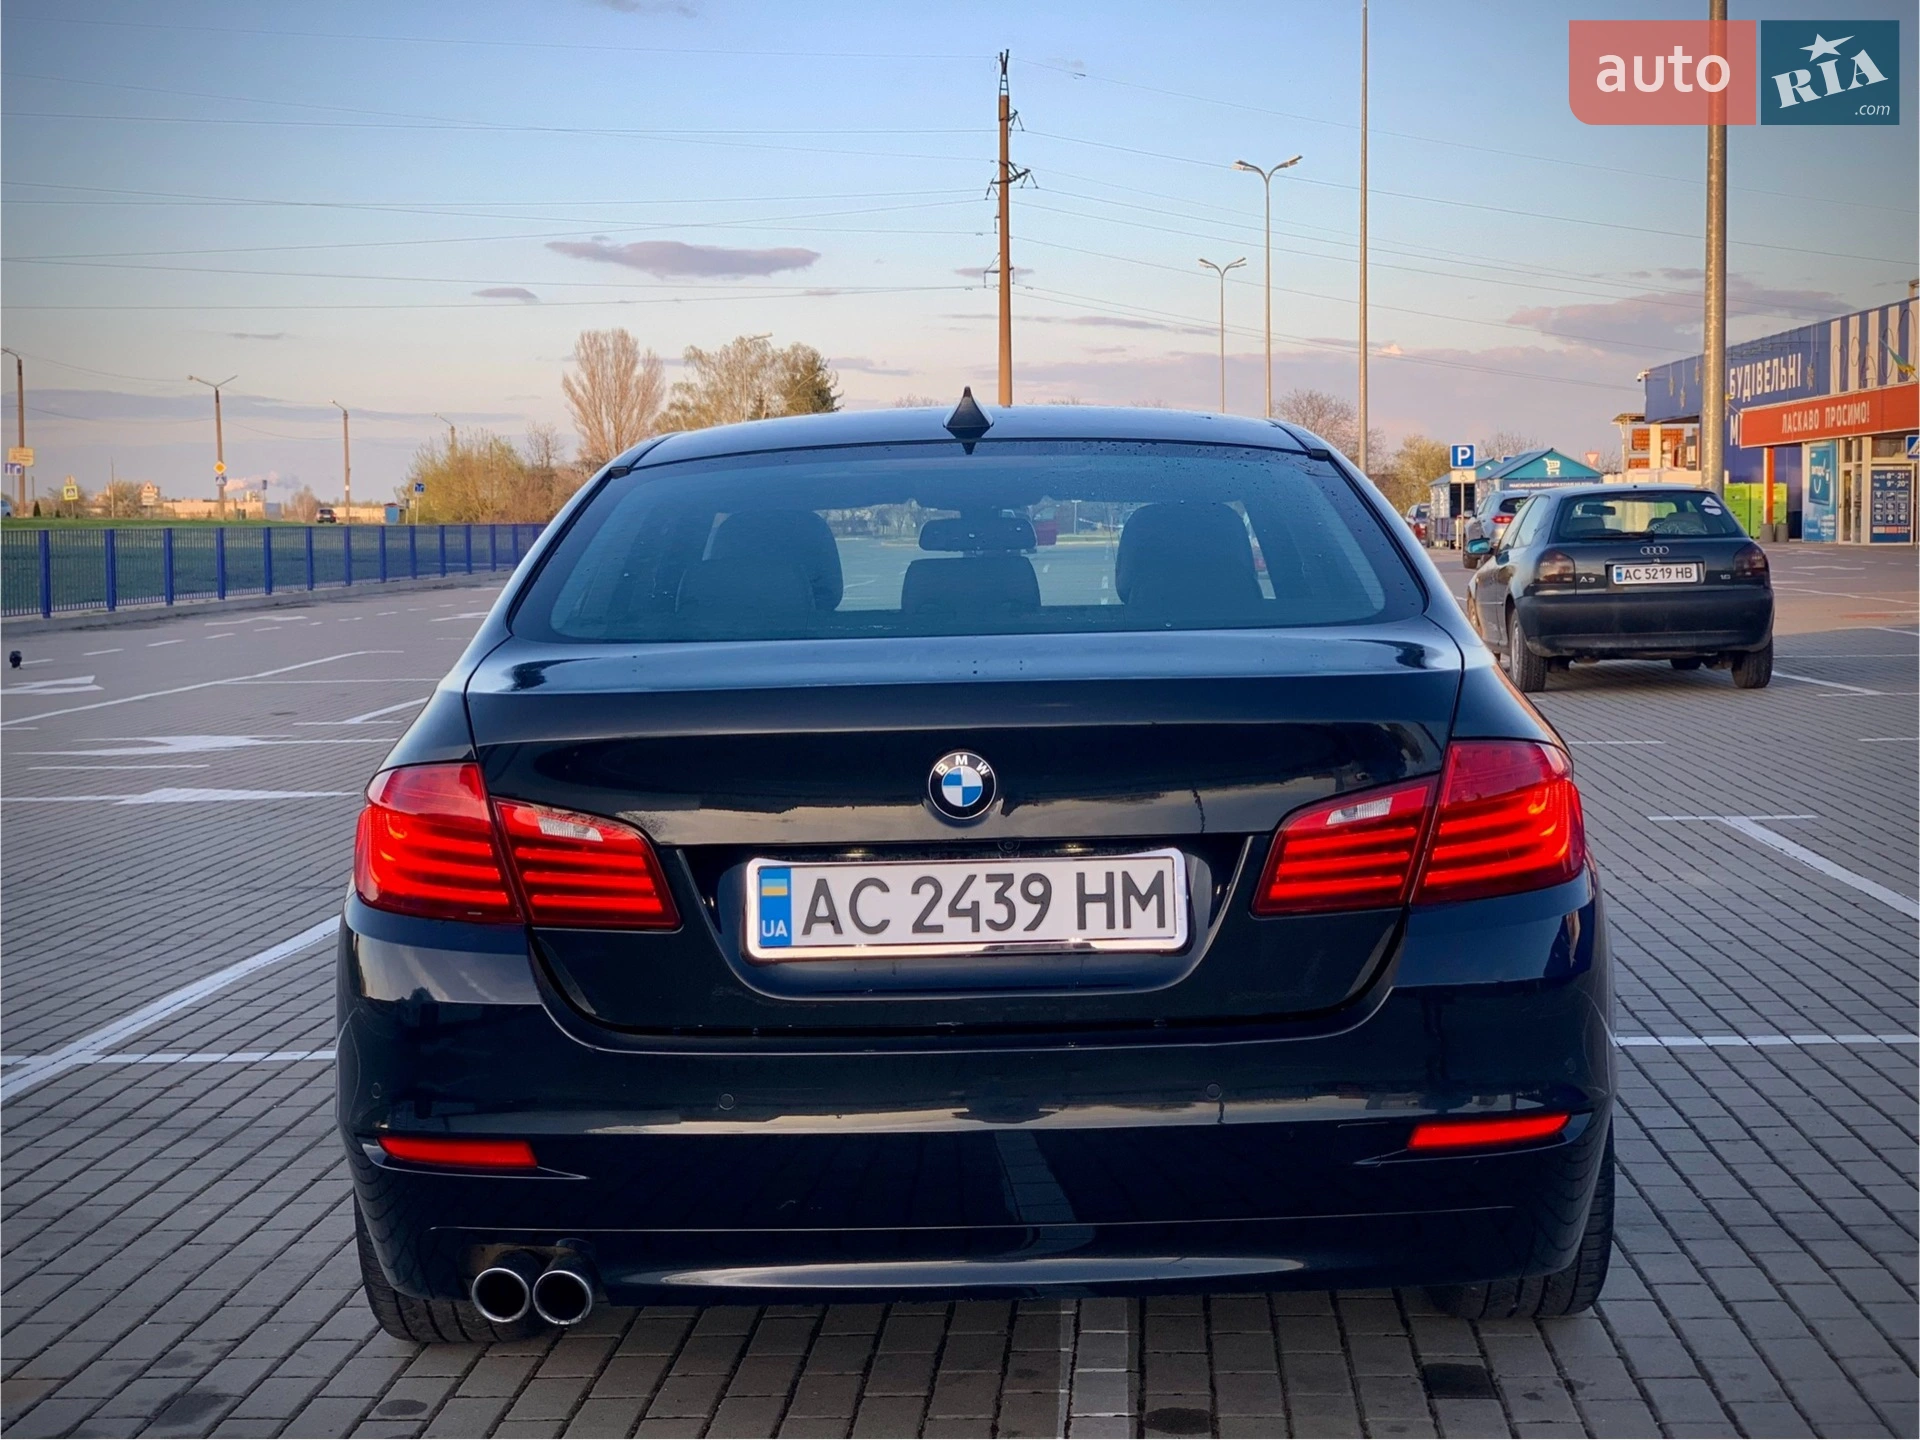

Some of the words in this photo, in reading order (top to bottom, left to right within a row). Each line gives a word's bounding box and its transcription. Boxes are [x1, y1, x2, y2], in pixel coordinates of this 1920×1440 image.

[1729, 353, 1801, 403] БУДІВЕЛЬНІ
[1782, 408, 1820, 434] ЛАСКАВО
[1825, 400, 1870, 428] ПРОСИМО!
[1457, 446, 1471, 466] P
[1624, 569, 1642, 580] AC
[1645, 567, 1672, 580] 5219
[1675, 567, 1693, 579] HB
[935, 754, 990, 776] BMW
[801, 877, 891, 936] AC
[910, 873, 1053, 934] 2439
[1076, 870, 1165, 930] HM
[761, 919, 789, 938] UA
